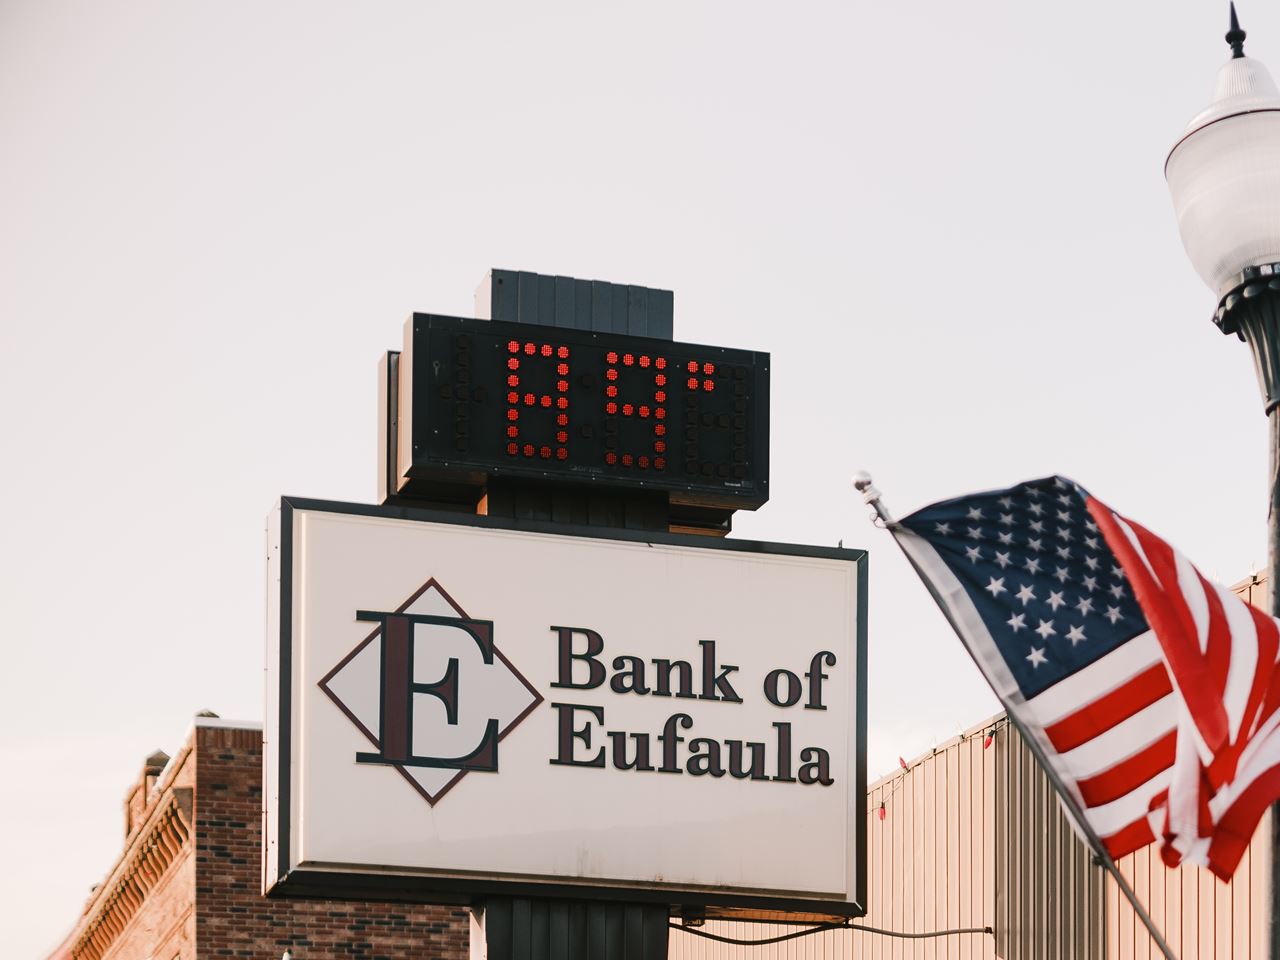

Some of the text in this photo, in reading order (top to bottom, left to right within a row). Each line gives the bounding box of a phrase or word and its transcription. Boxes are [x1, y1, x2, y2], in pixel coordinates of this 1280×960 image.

[356, 610, 499, 773] E
[550, 625, 837, 710] Bank of
[549, 702, 835, 786] Eufaula
